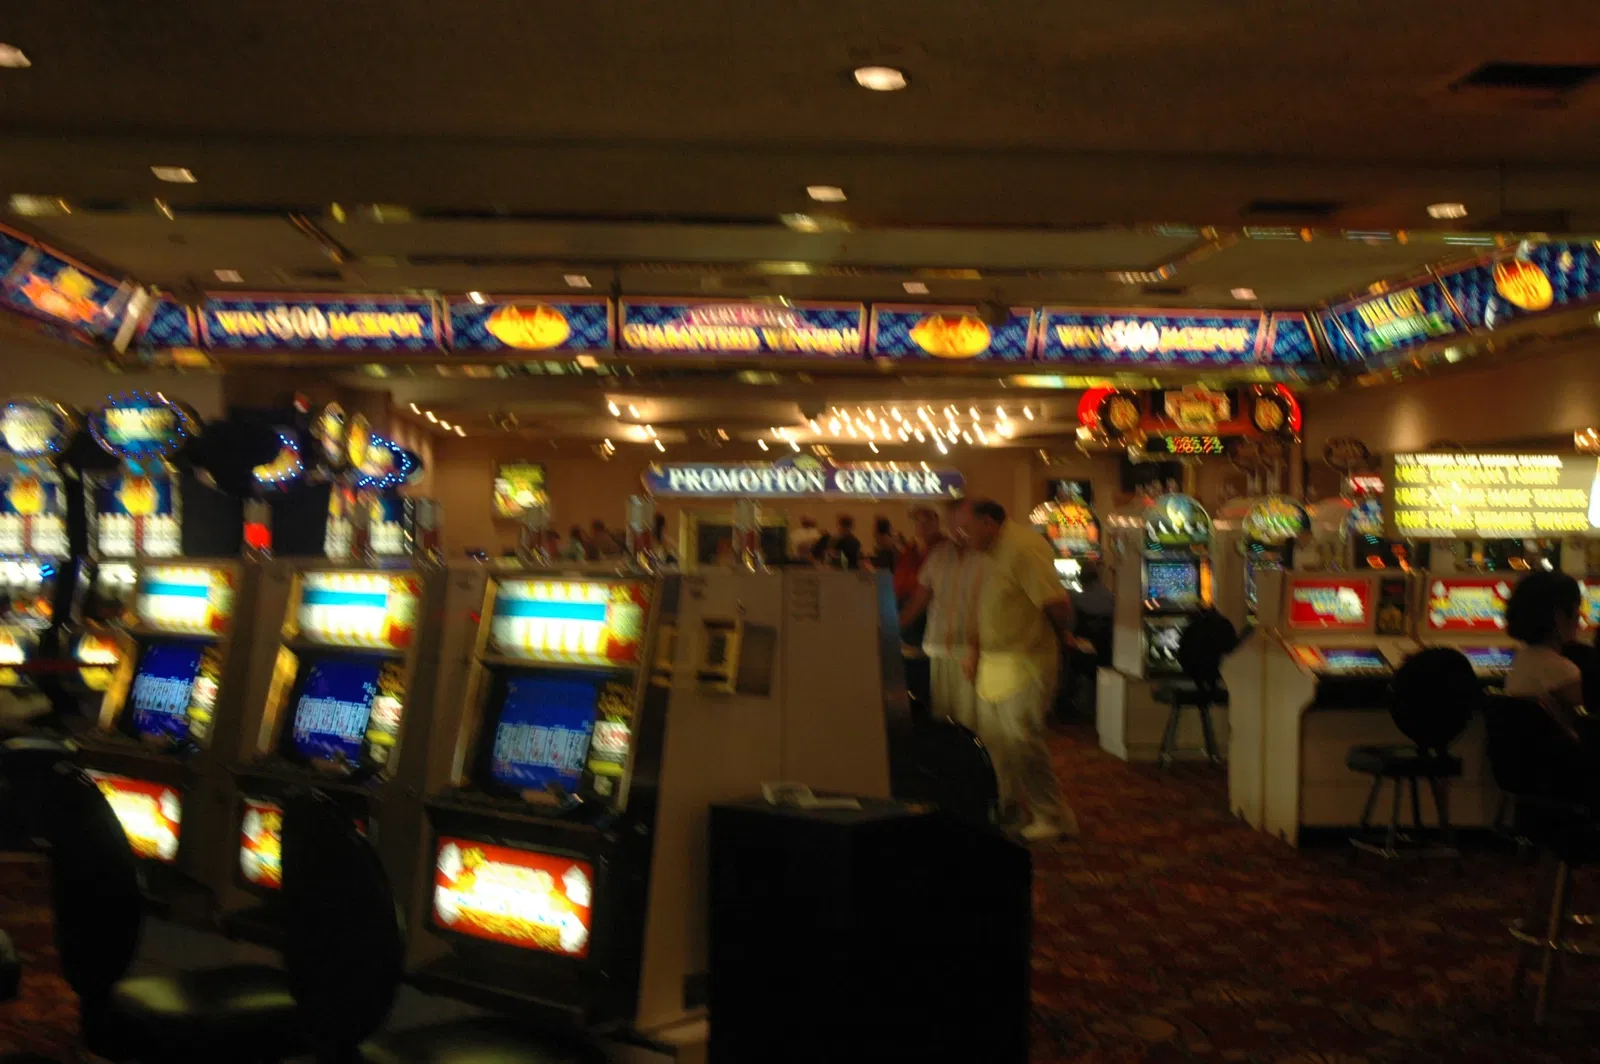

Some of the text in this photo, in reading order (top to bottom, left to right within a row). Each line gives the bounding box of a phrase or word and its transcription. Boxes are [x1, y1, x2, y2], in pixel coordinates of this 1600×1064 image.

[214, 309, 267, 336] WIN
[668, 466, 944, 494] PROMOTION CENTER
